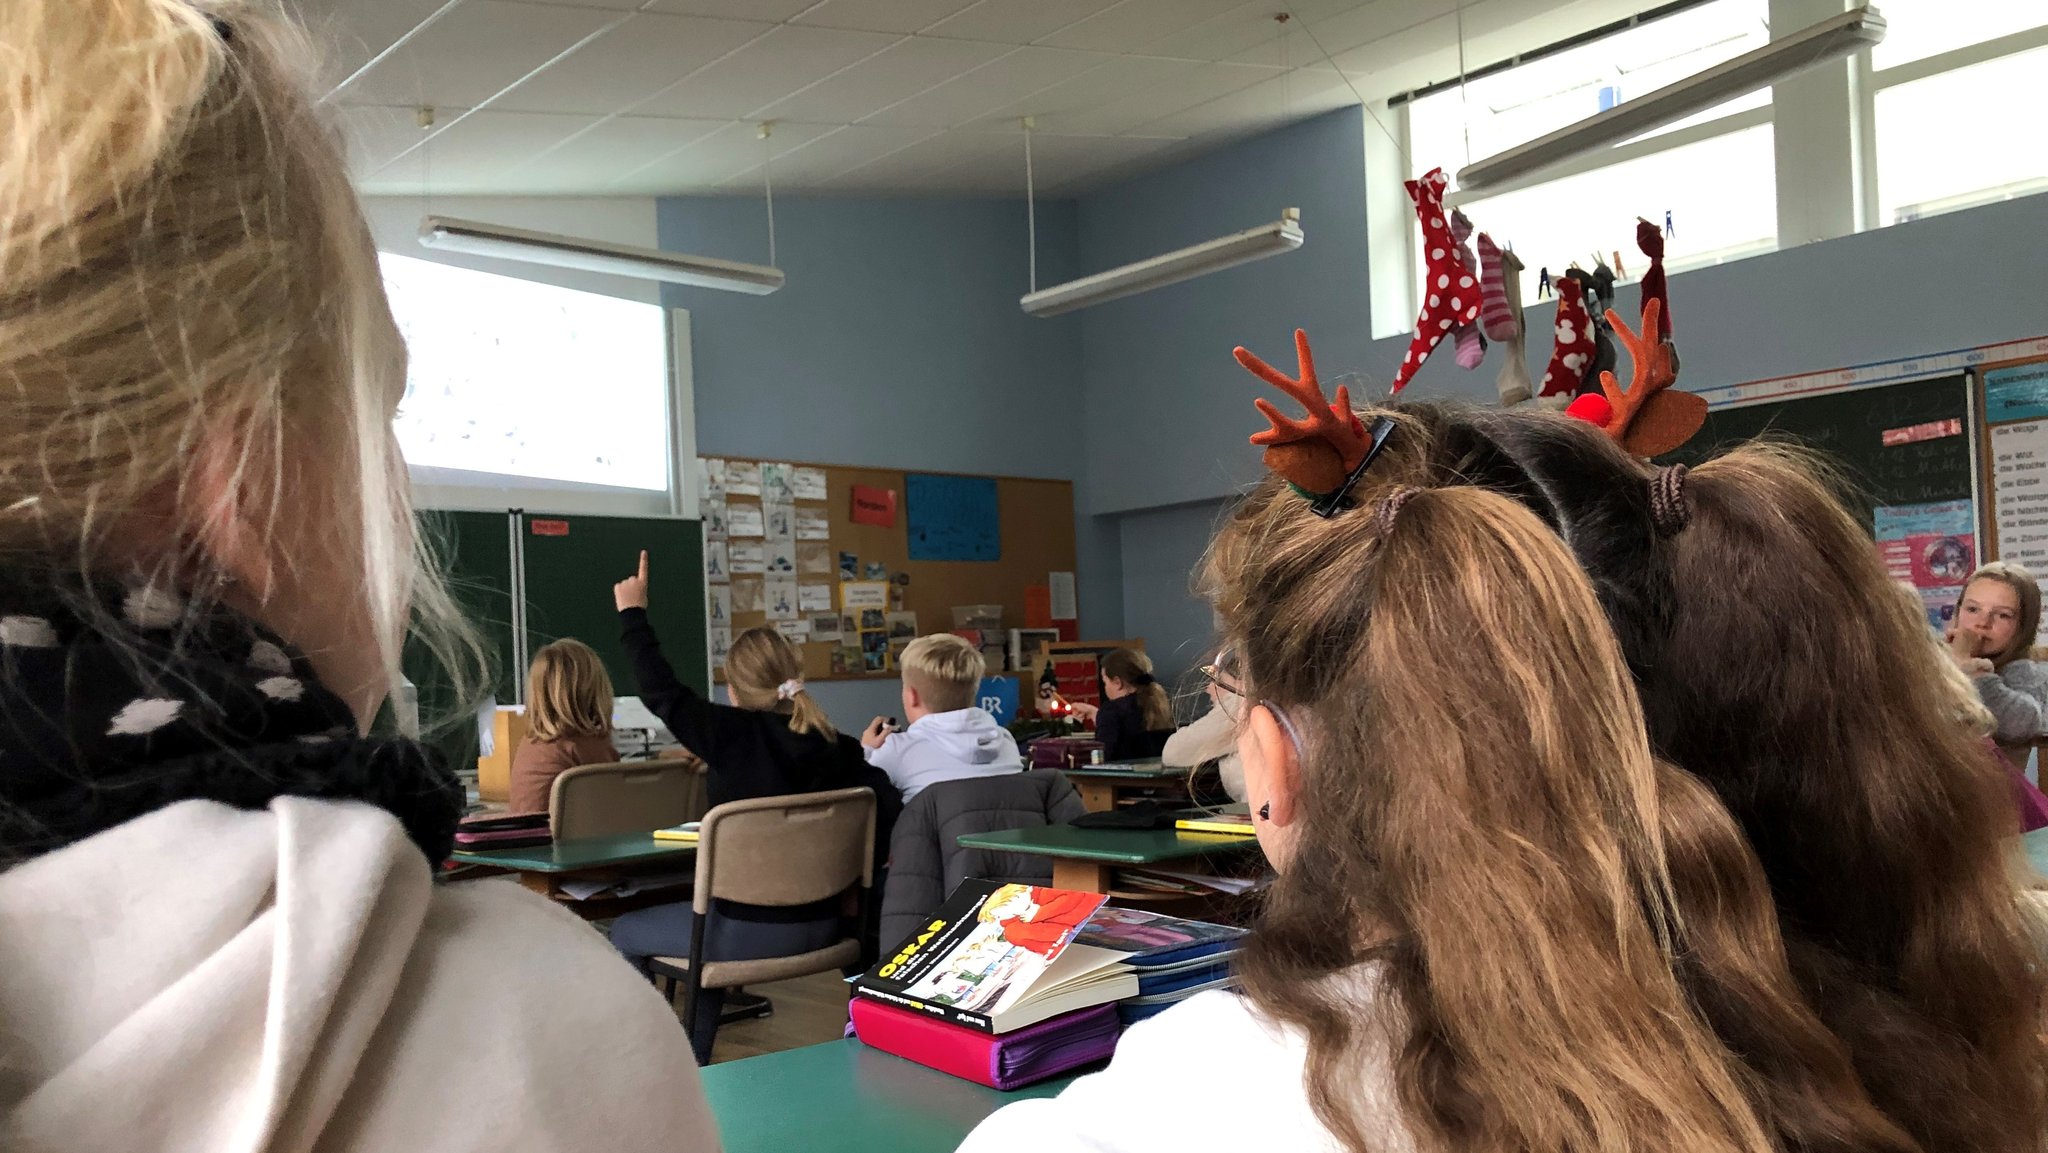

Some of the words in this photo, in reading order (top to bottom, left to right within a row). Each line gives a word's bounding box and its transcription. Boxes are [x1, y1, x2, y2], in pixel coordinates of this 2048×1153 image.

[981, 696, 1004, 714] BR
[878, 919, 947, 978] OSKAR
[895, 952, 930, 980] falschen
